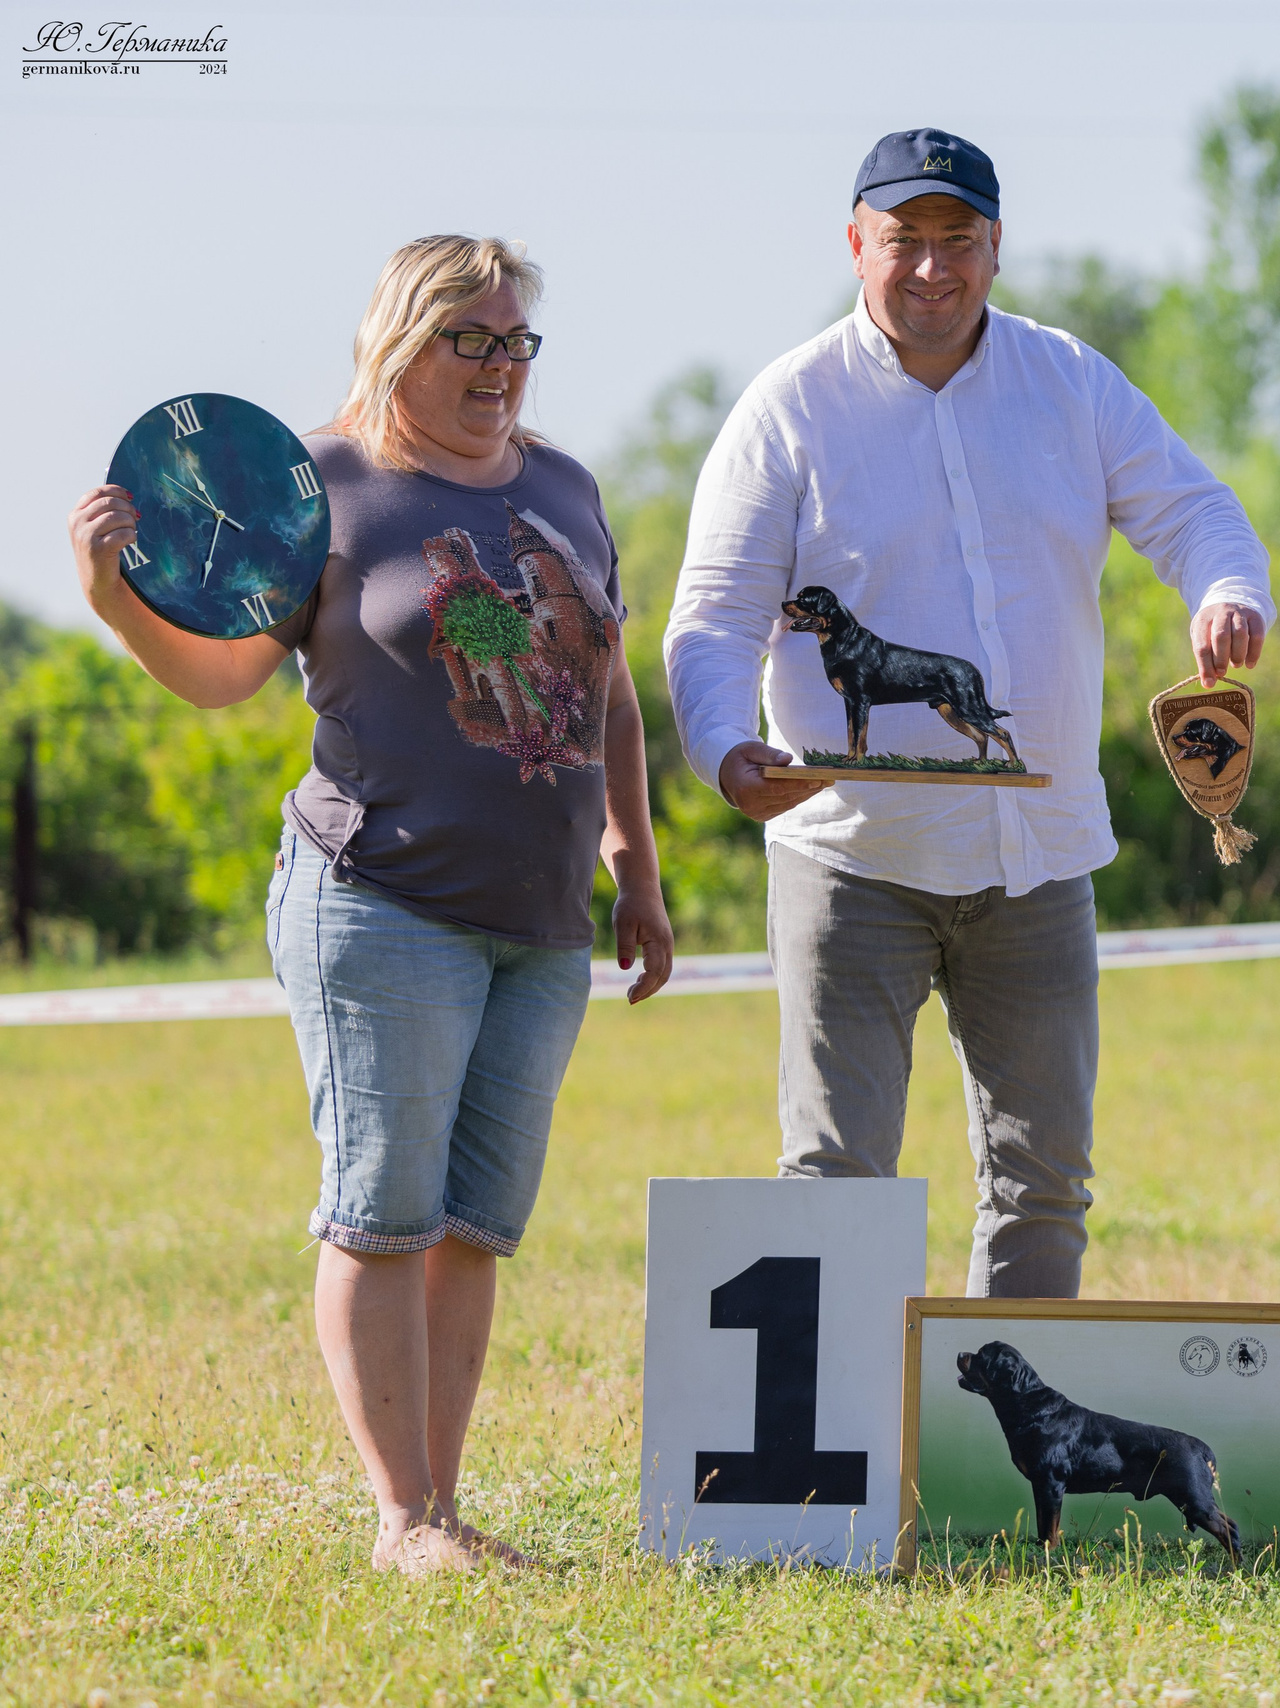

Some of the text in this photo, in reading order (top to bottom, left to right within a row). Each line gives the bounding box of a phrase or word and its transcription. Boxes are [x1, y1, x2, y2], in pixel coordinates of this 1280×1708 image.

[163, 398, 204, 440] XII
[289, 461, 322, 500] III
[241, 592, 276, 629] VI
[694, 1257, 868, 1505] 1
